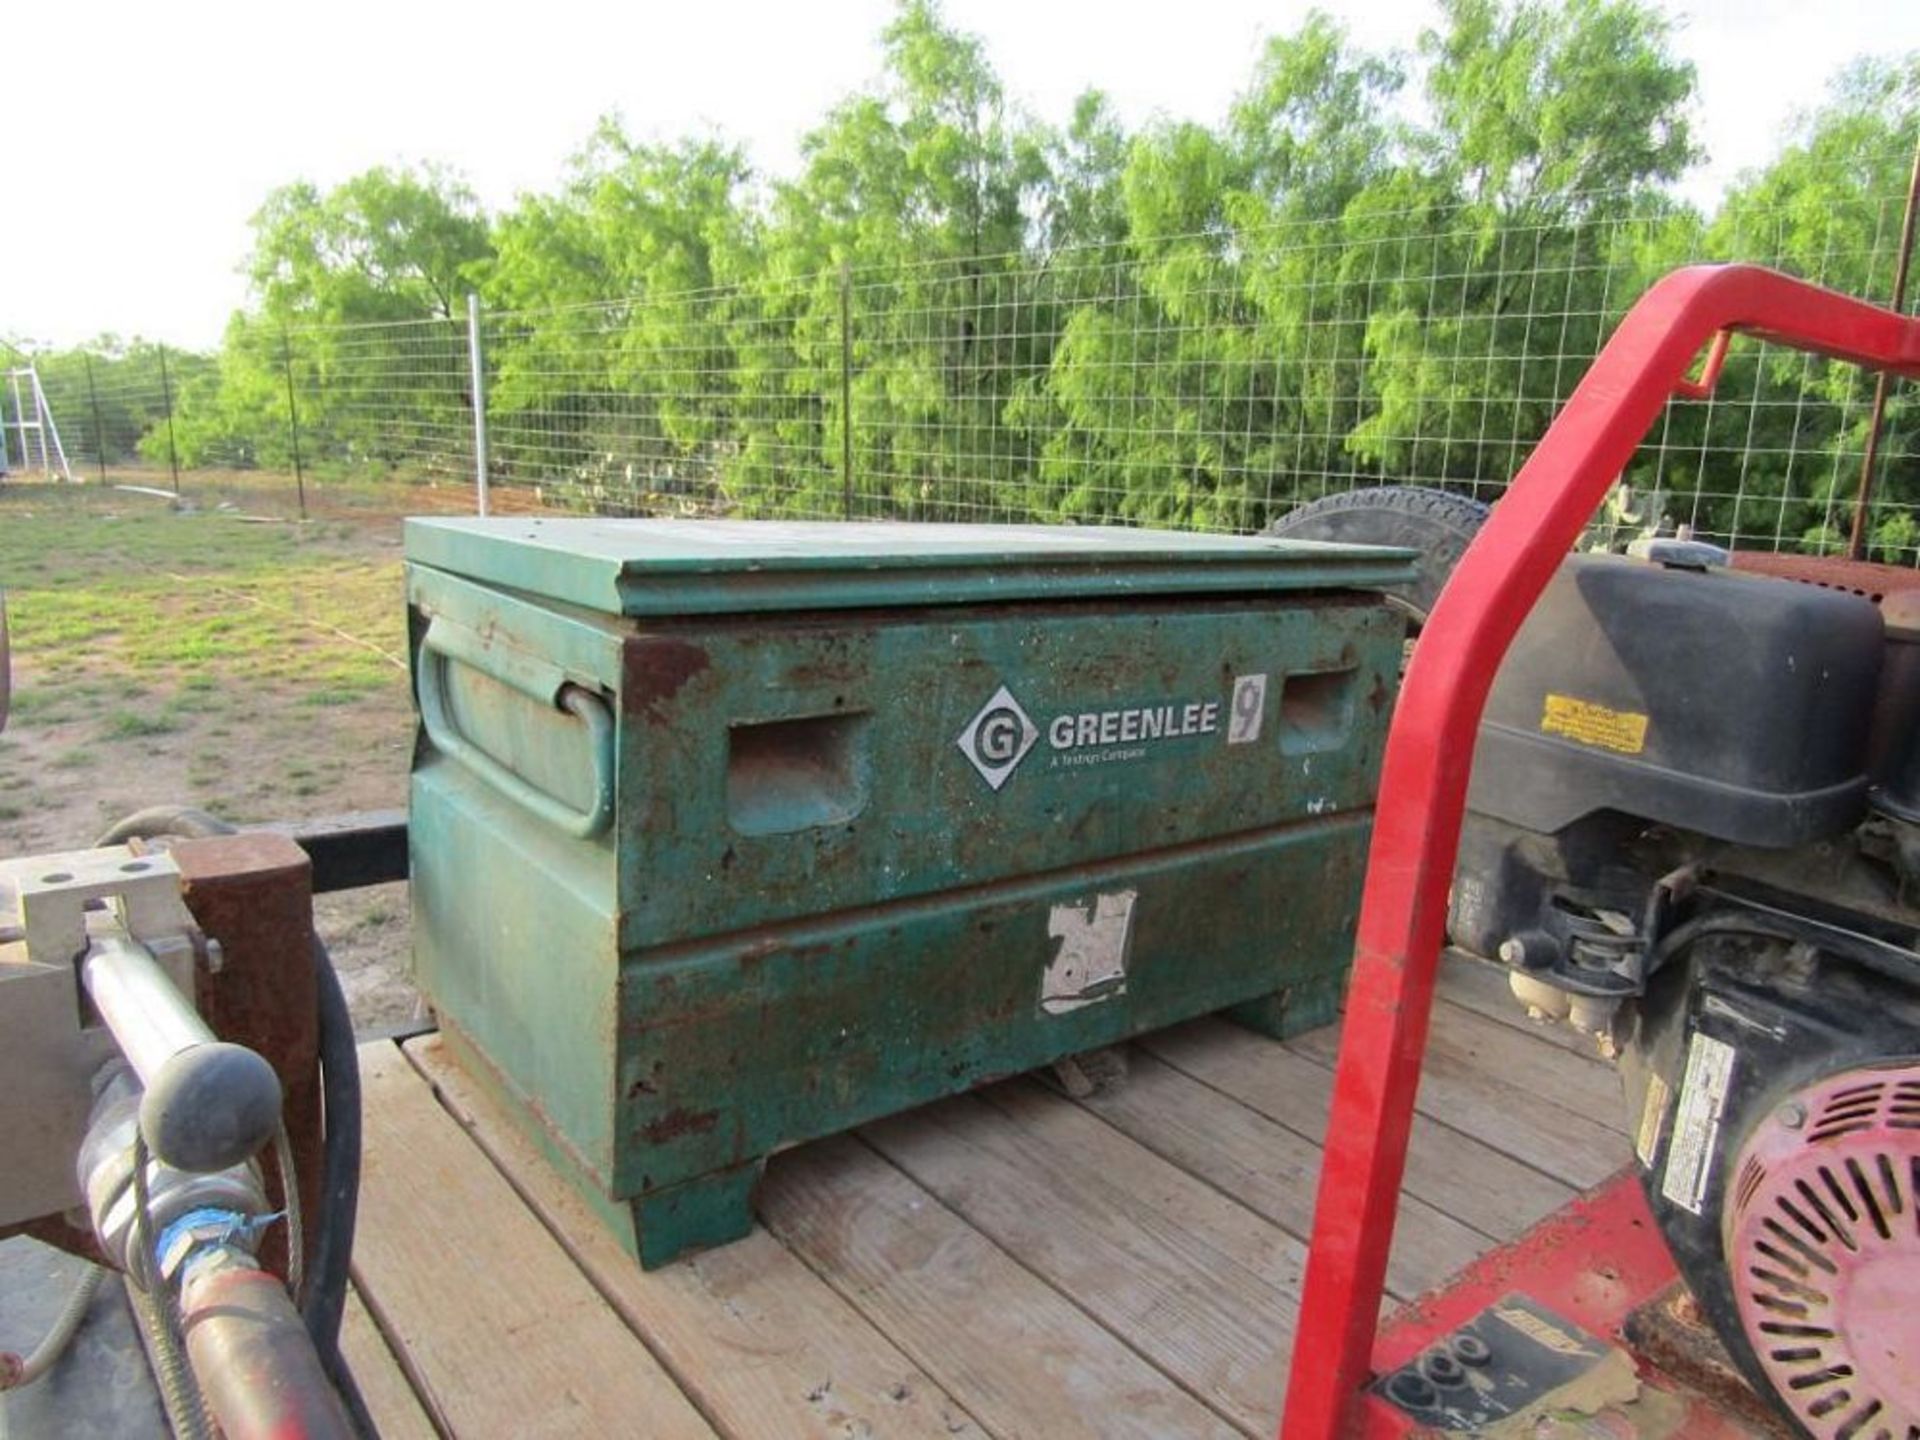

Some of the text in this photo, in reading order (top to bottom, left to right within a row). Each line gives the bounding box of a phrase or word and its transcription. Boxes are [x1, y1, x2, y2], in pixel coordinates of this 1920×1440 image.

[1049, 702, 1219, 749] GREENLEE
[1236, 680, 1261, 740] 9
[981, 715, 1014, 760] G
